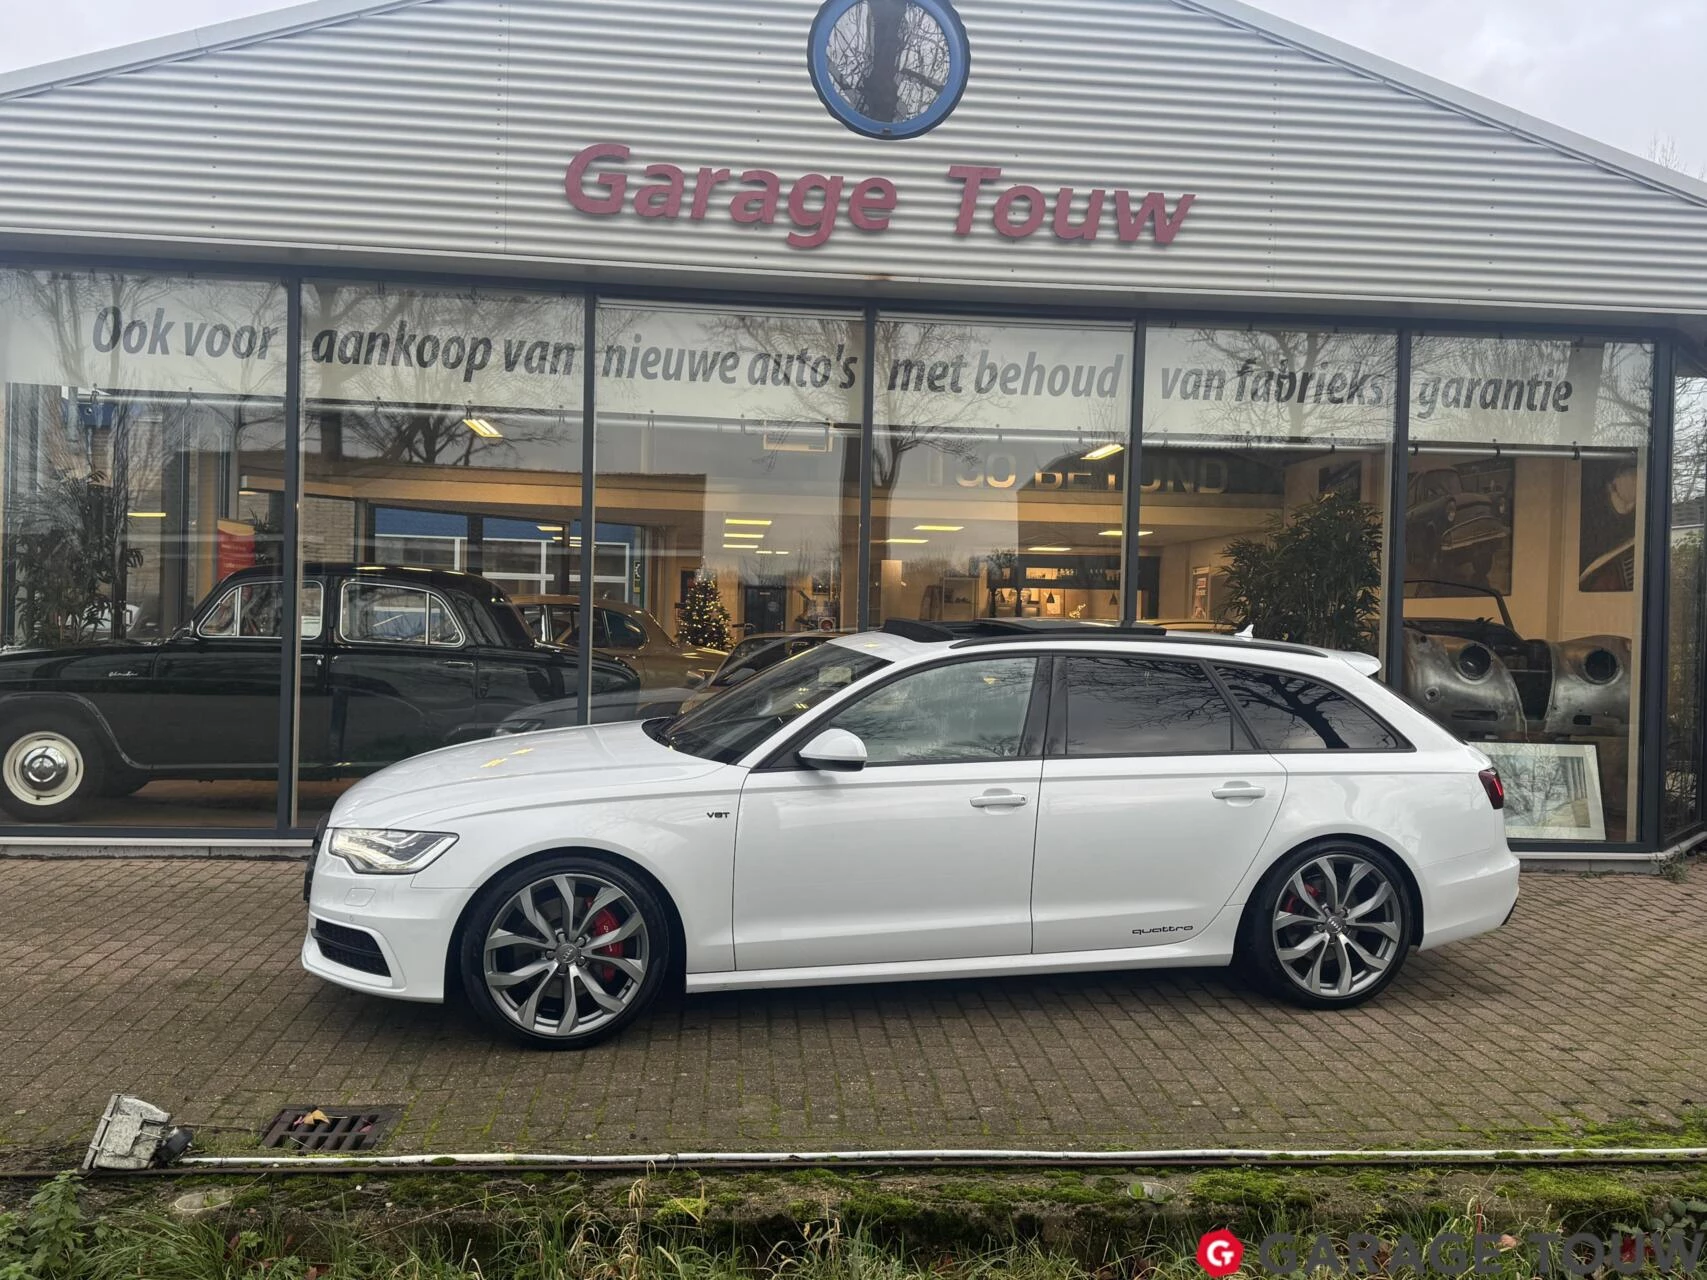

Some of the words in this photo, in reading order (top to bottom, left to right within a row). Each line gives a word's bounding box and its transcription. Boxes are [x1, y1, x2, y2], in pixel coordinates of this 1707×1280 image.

[564, 143, 898, 249] Garage
[947, 165, 1197, 245] Touw
[92, 305, 175, 353] Ook
[184, 321, 279, 361] voor
[311, 319, 493, 382] aankoop
[503, 338, 576, 376] van
[600, 332, 739, 386] nieuwe
[747, 342, 858, 391] auto's
[887, 351, 968, 394] met
[974, 348, 1125, 399] behoud
[1160, 366, 1226, 401] van
[1233, 357, 1386, 408] fabrieks
[1415, 367, 1574, 420] garantie
[1131, 925, 1194, 936] quattro
